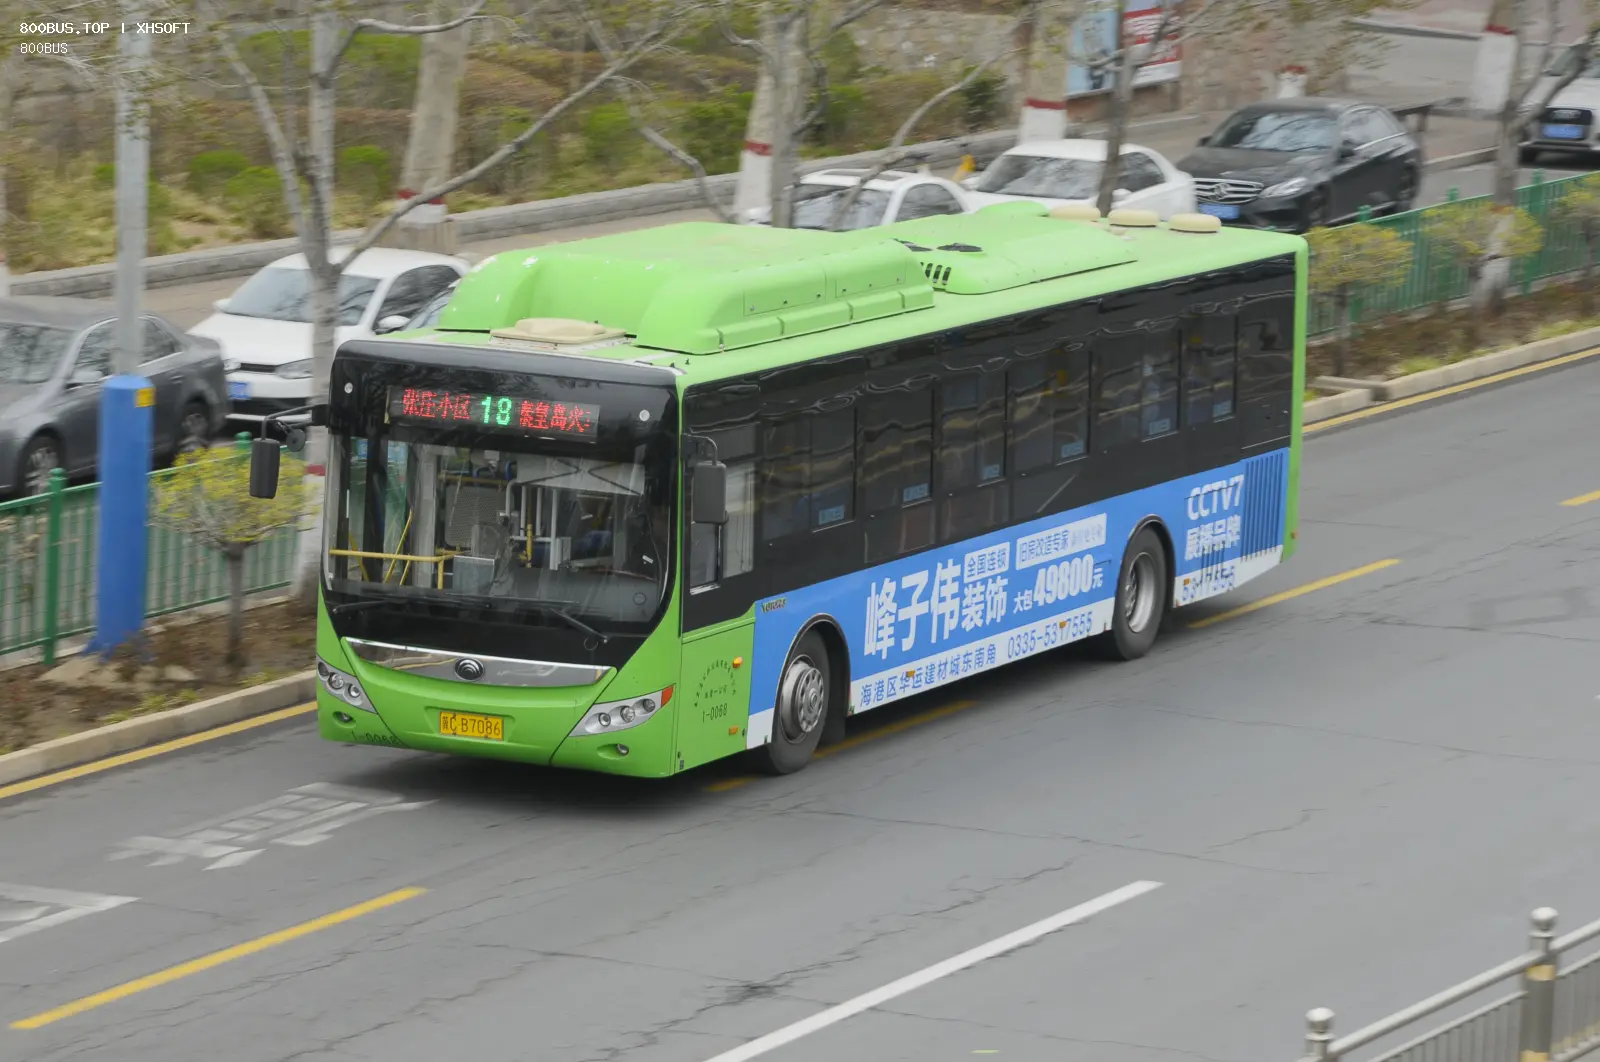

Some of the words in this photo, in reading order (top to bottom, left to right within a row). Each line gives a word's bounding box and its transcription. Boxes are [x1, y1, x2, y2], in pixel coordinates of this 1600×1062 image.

[482, 396, 512, 426] 18
[1187, 474, 1244, 521] CCTV7
[967, 548, 1007, 578] 全国连锁
[864, 558, 961, 660] 峰子伟
[961, 576, 1009, 632] 装饰
[860, 643, 997, 707] 海港区华运建材城东南角
